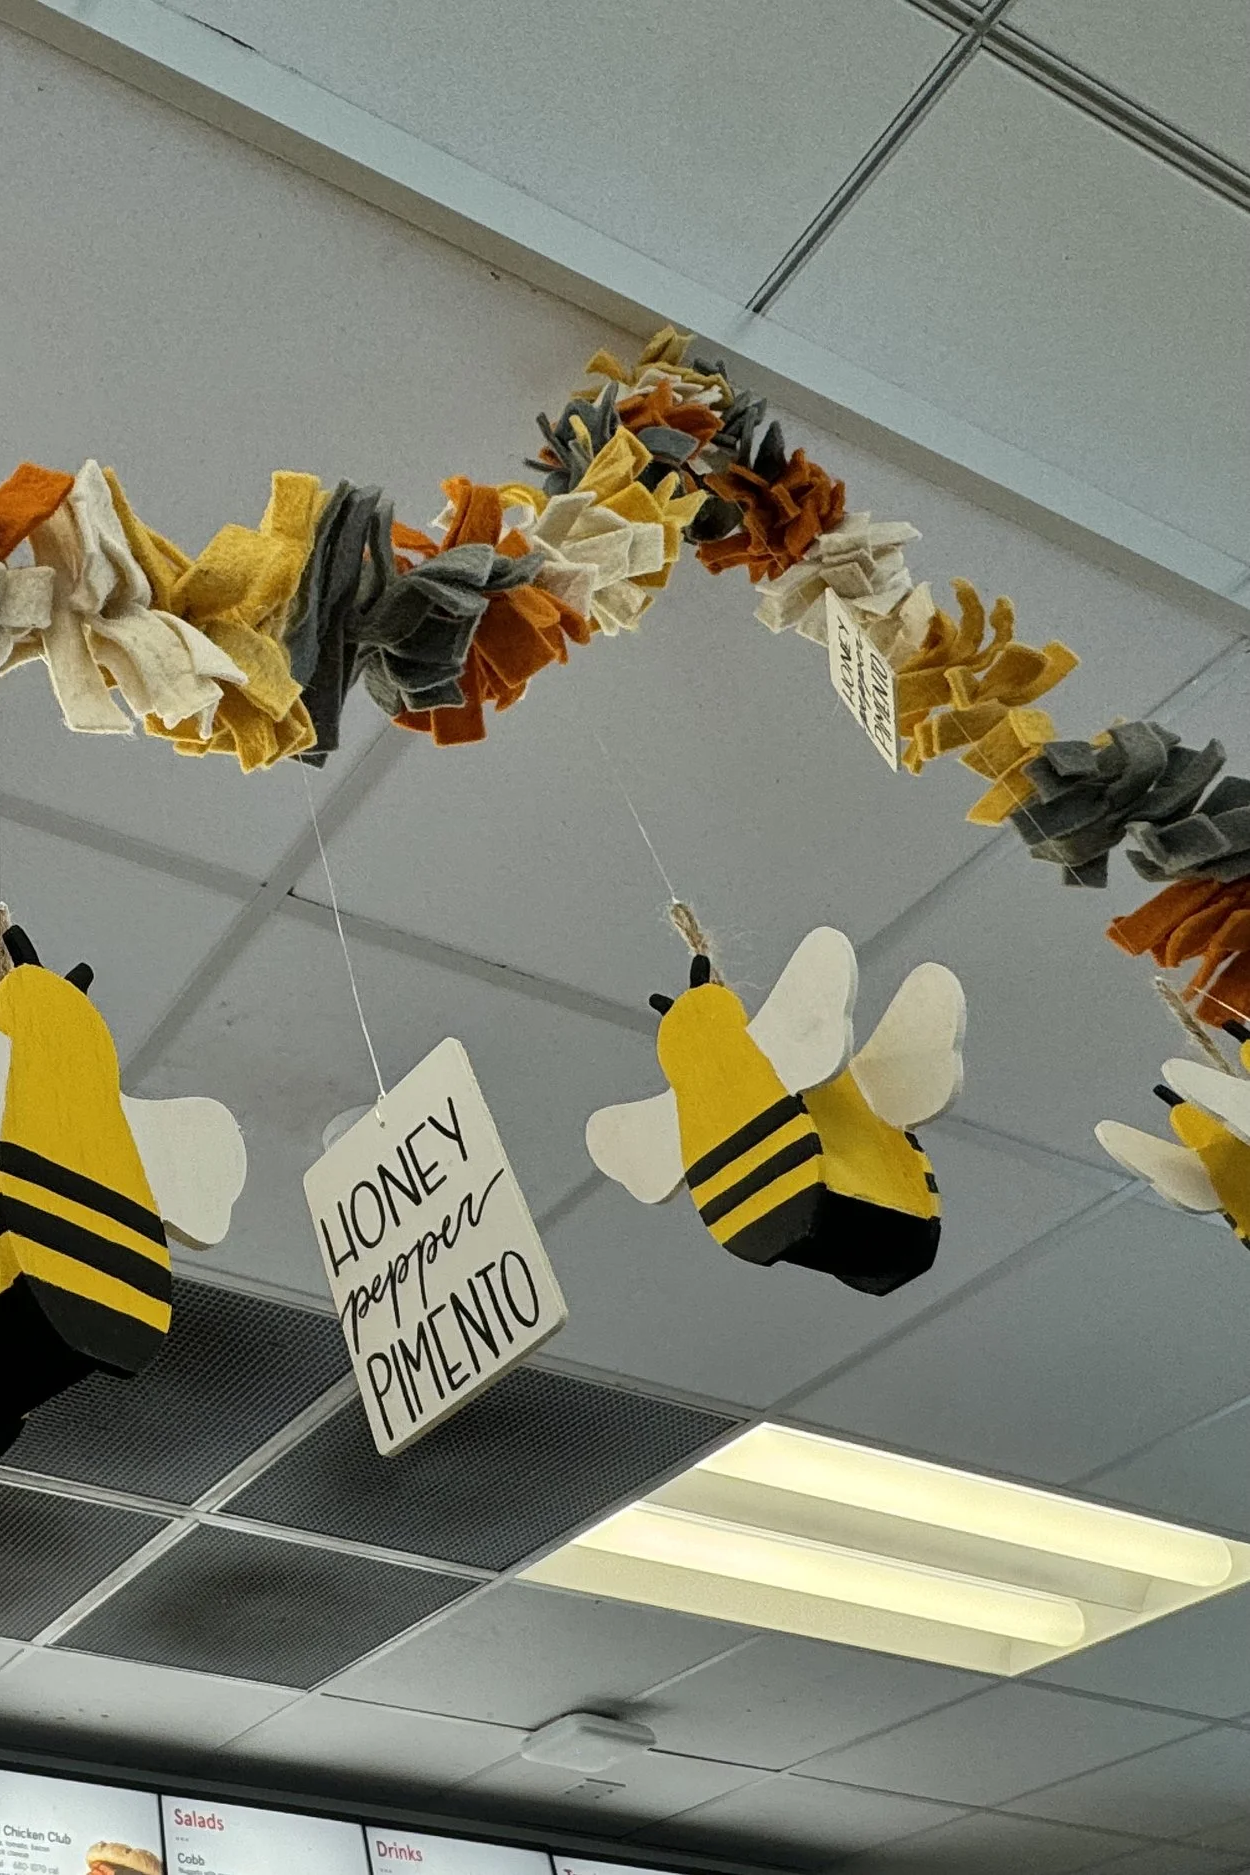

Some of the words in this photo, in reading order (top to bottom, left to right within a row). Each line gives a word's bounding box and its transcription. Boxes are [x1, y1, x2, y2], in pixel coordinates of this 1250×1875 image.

[837, 616, 855, 707] HONEY
[870, 652, 893, 757] PIMENTO
[320, 1097, 468, 1277] HONEY
[341, 1168, 504, 1355] pepper
[366, 1251, 540, 1441] PIMENTO
[3, 1825, 45, 1841] Chicken
[47, 1831, 72, 1845] Club
[174, 1808, 225, 1831] Salads
[178, 1852, 205, 1866] Cobb
[376, 1840, 423, 1862] Drinks
